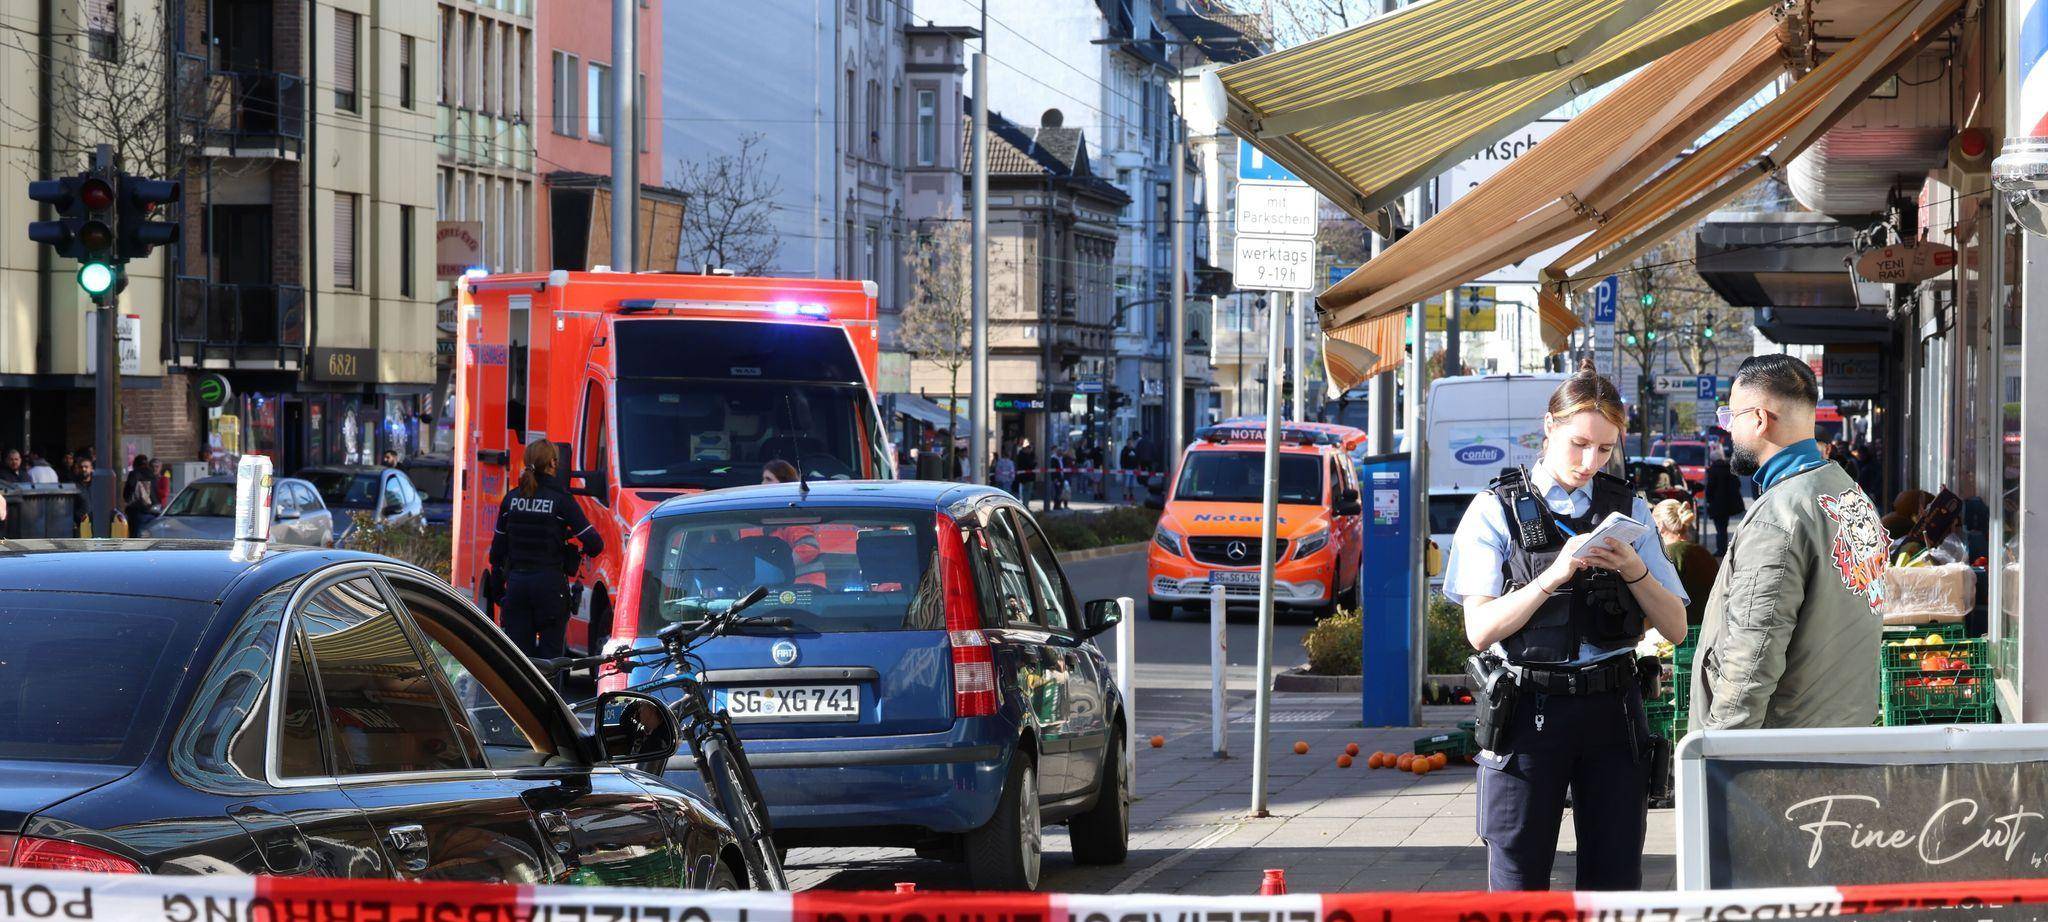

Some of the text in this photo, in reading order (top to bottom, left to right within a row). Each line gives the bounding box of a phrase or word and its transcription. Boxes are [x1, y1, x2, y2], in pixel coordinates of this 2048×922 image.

[1267, 197, 1287, 208] mit
[1243, 210, 1311, 226] Parkschein
[1242, 247, 1308, 265] werktags
[328, 353, 357, 376] 6821
[1031, 400, 1044, 408] End
[1230, 429, 1288, 441] NOTAT
[1461, 449, 1498, 461] confeti
[510, 497, 554, 514] POLIZEI
[1194, 513, 1288, 525] Notart
[776, 648, 795, 658] FIAT
[731, 688, 855, 713] SG XG 741
[1785, 794, 2045, 869] Fine Cut
